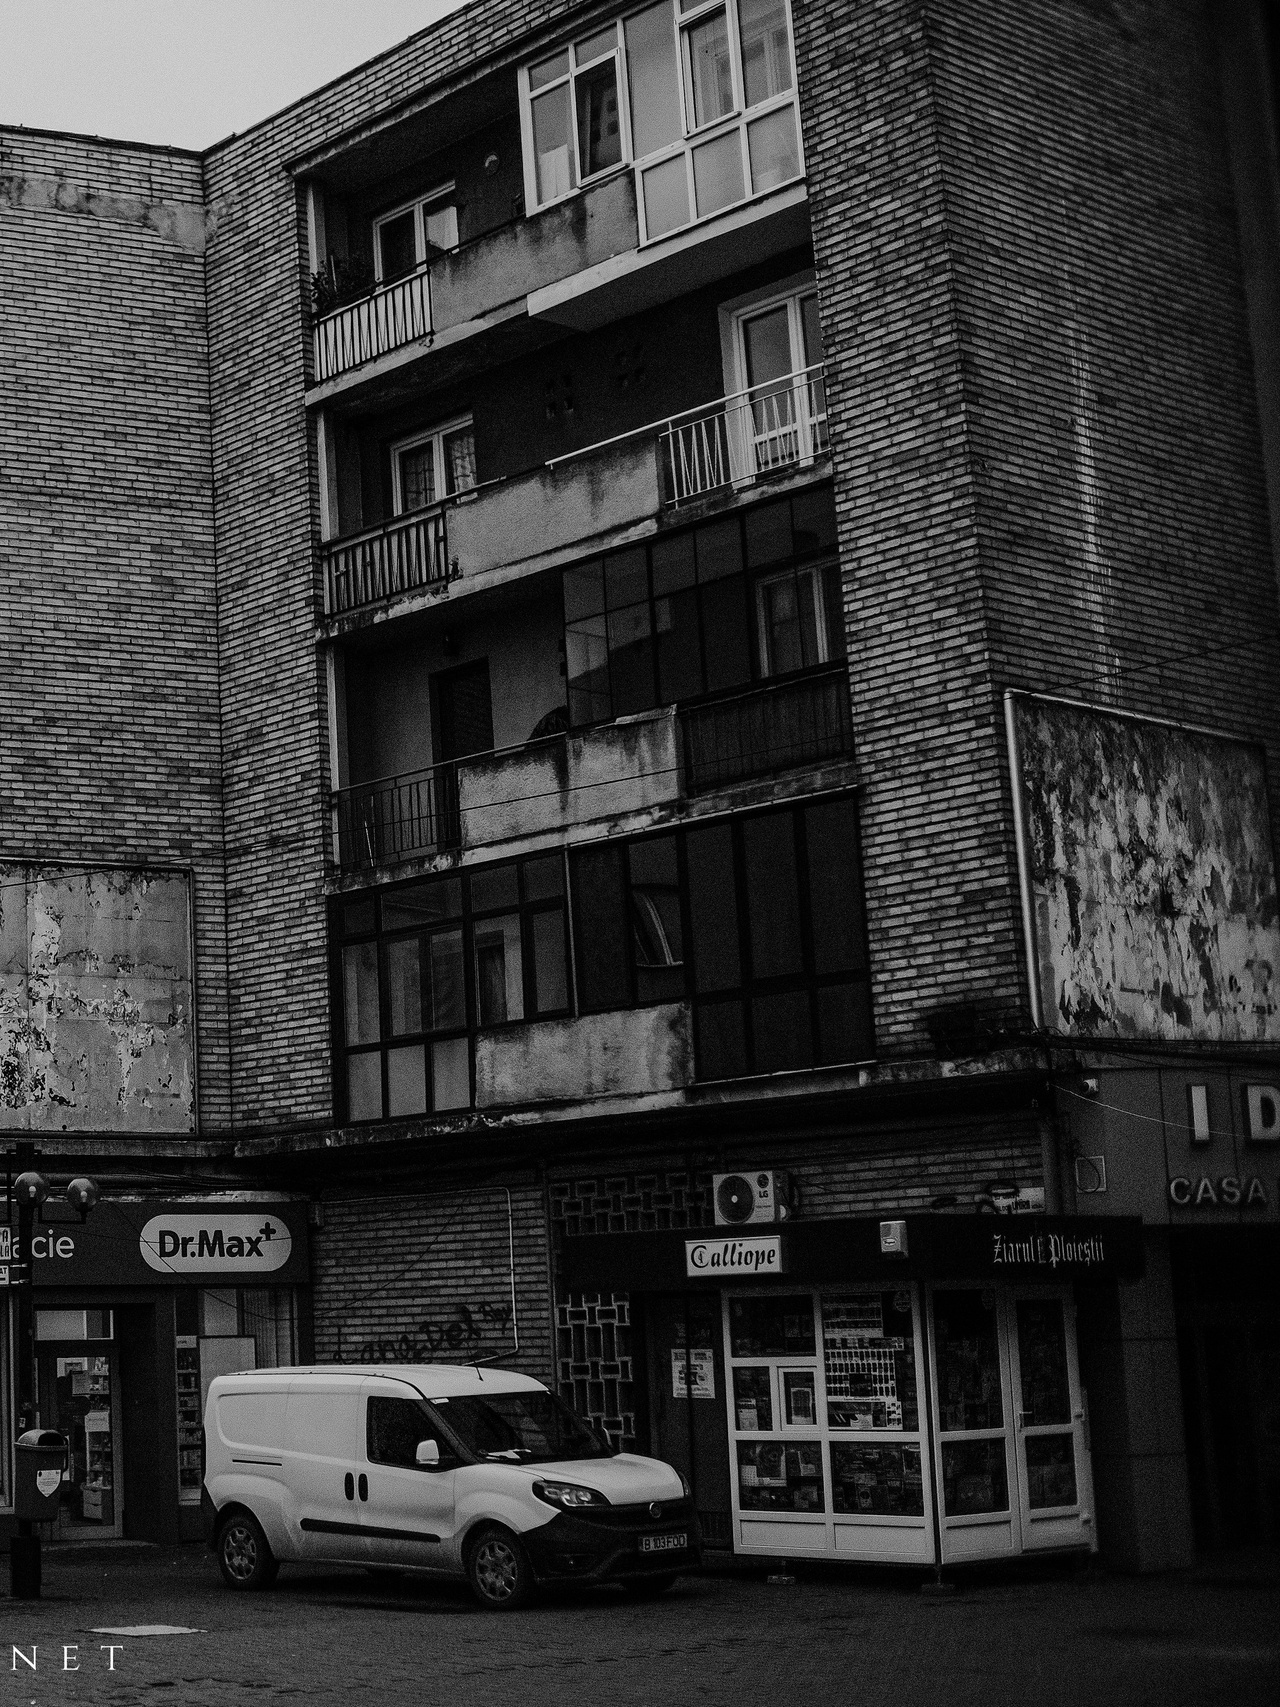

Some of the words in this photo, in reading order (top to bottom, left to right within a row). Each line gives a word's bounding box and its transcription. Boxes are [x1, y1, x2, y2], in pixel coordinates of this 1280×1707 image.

[758, 1190, 768, 1198] LG
[1170, 1177, 1268, 1204] CASA
[690, 1242, 776, 1271] Calliope
